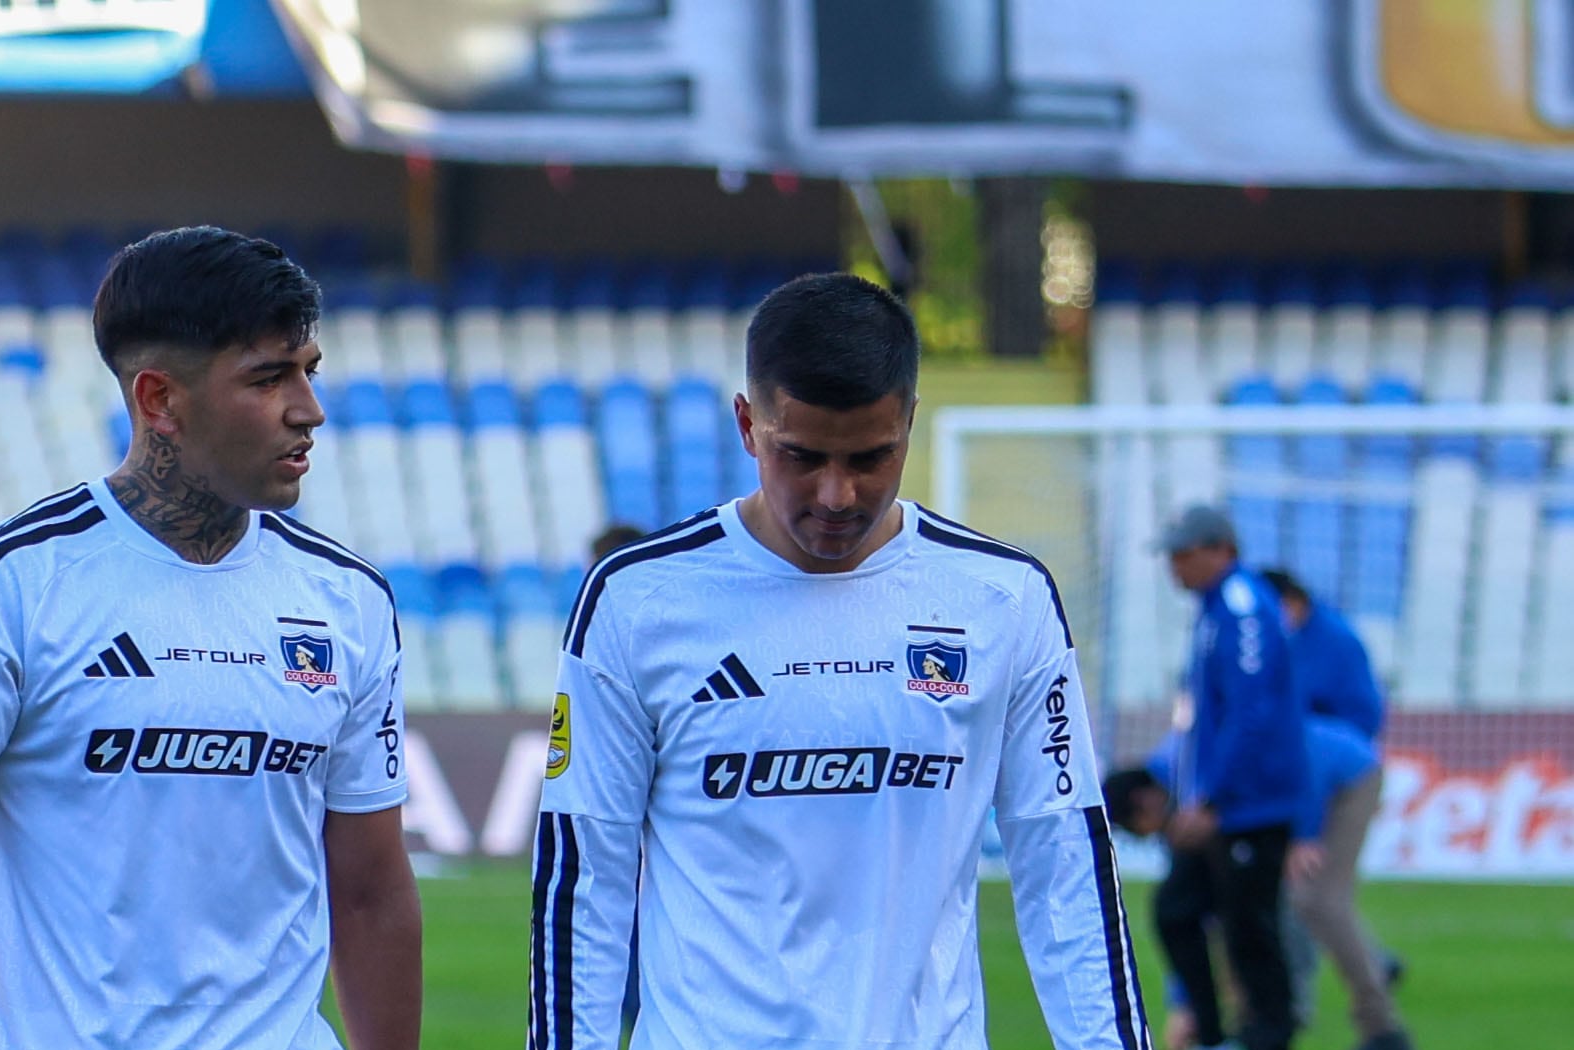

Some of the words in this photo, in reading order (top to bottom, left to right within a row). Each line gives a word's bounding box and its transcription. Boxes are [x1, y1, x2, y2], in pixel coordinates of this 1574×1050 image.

[154, 647, 266, 666] JETOUR
[772, 660, 895, 677] JETOUR
[284, 671, 338, 686] COLO-COLO
[908, 679, 969, 696] COLO-COLO
